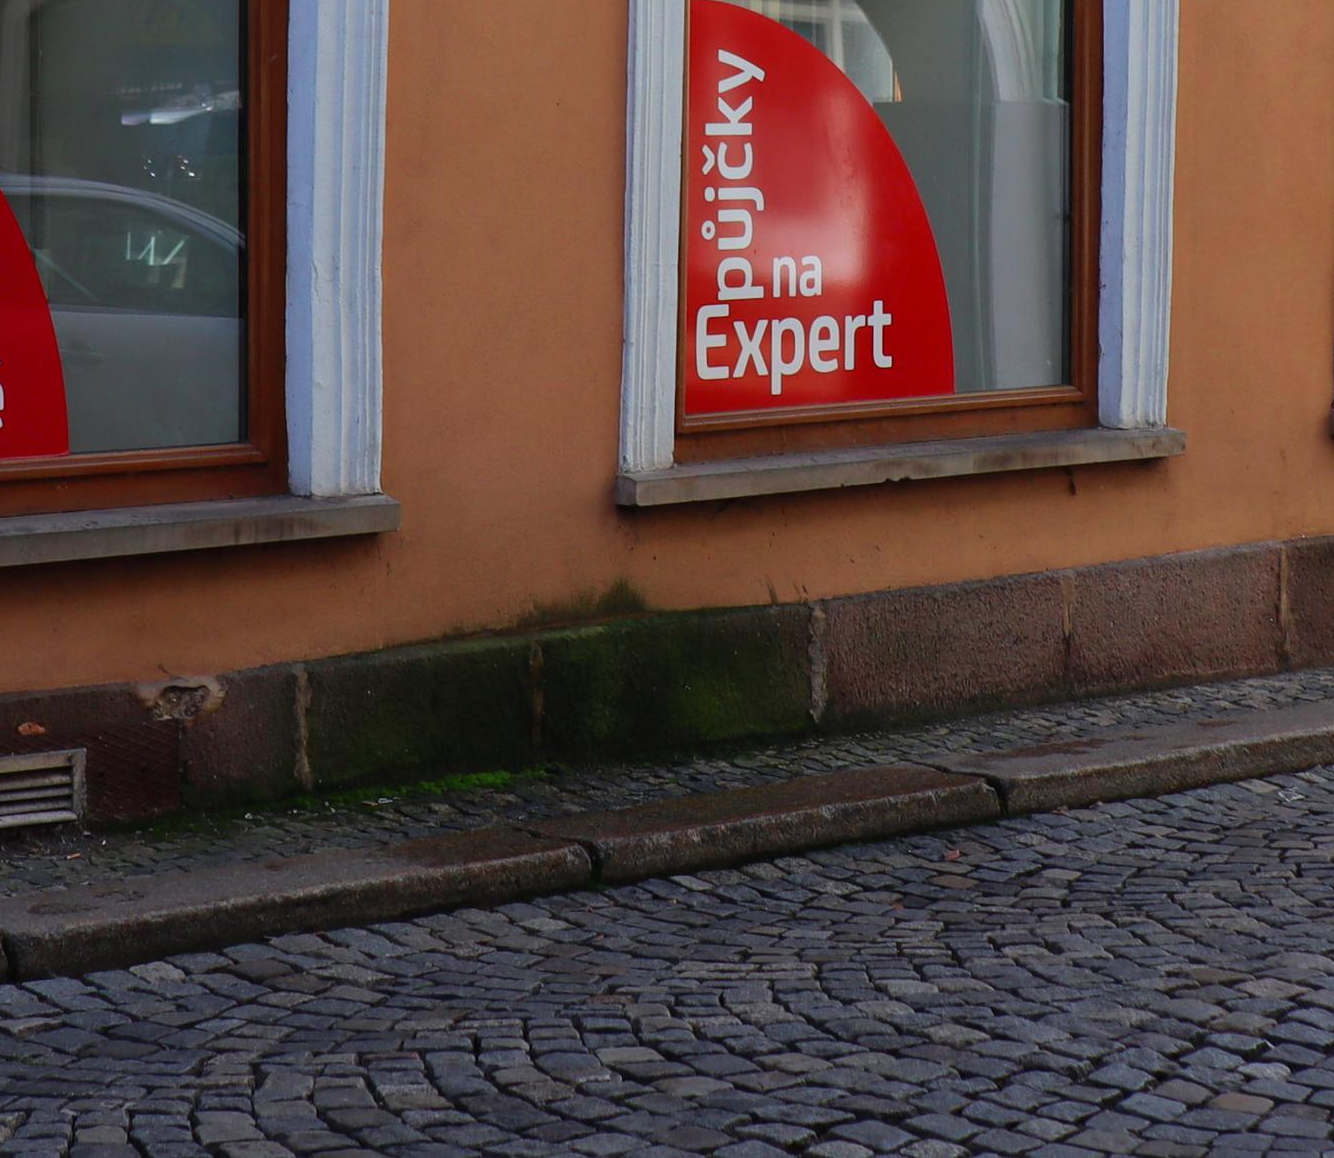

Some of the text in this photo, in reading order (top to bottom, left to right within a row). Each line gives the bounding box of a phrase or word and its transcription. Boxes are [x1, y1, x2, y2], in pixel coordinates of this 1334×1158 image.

[701, 48, 766, 302] půjčky
[772, 253, 823, 299] na
[695, 299, 893, 396] Expert
